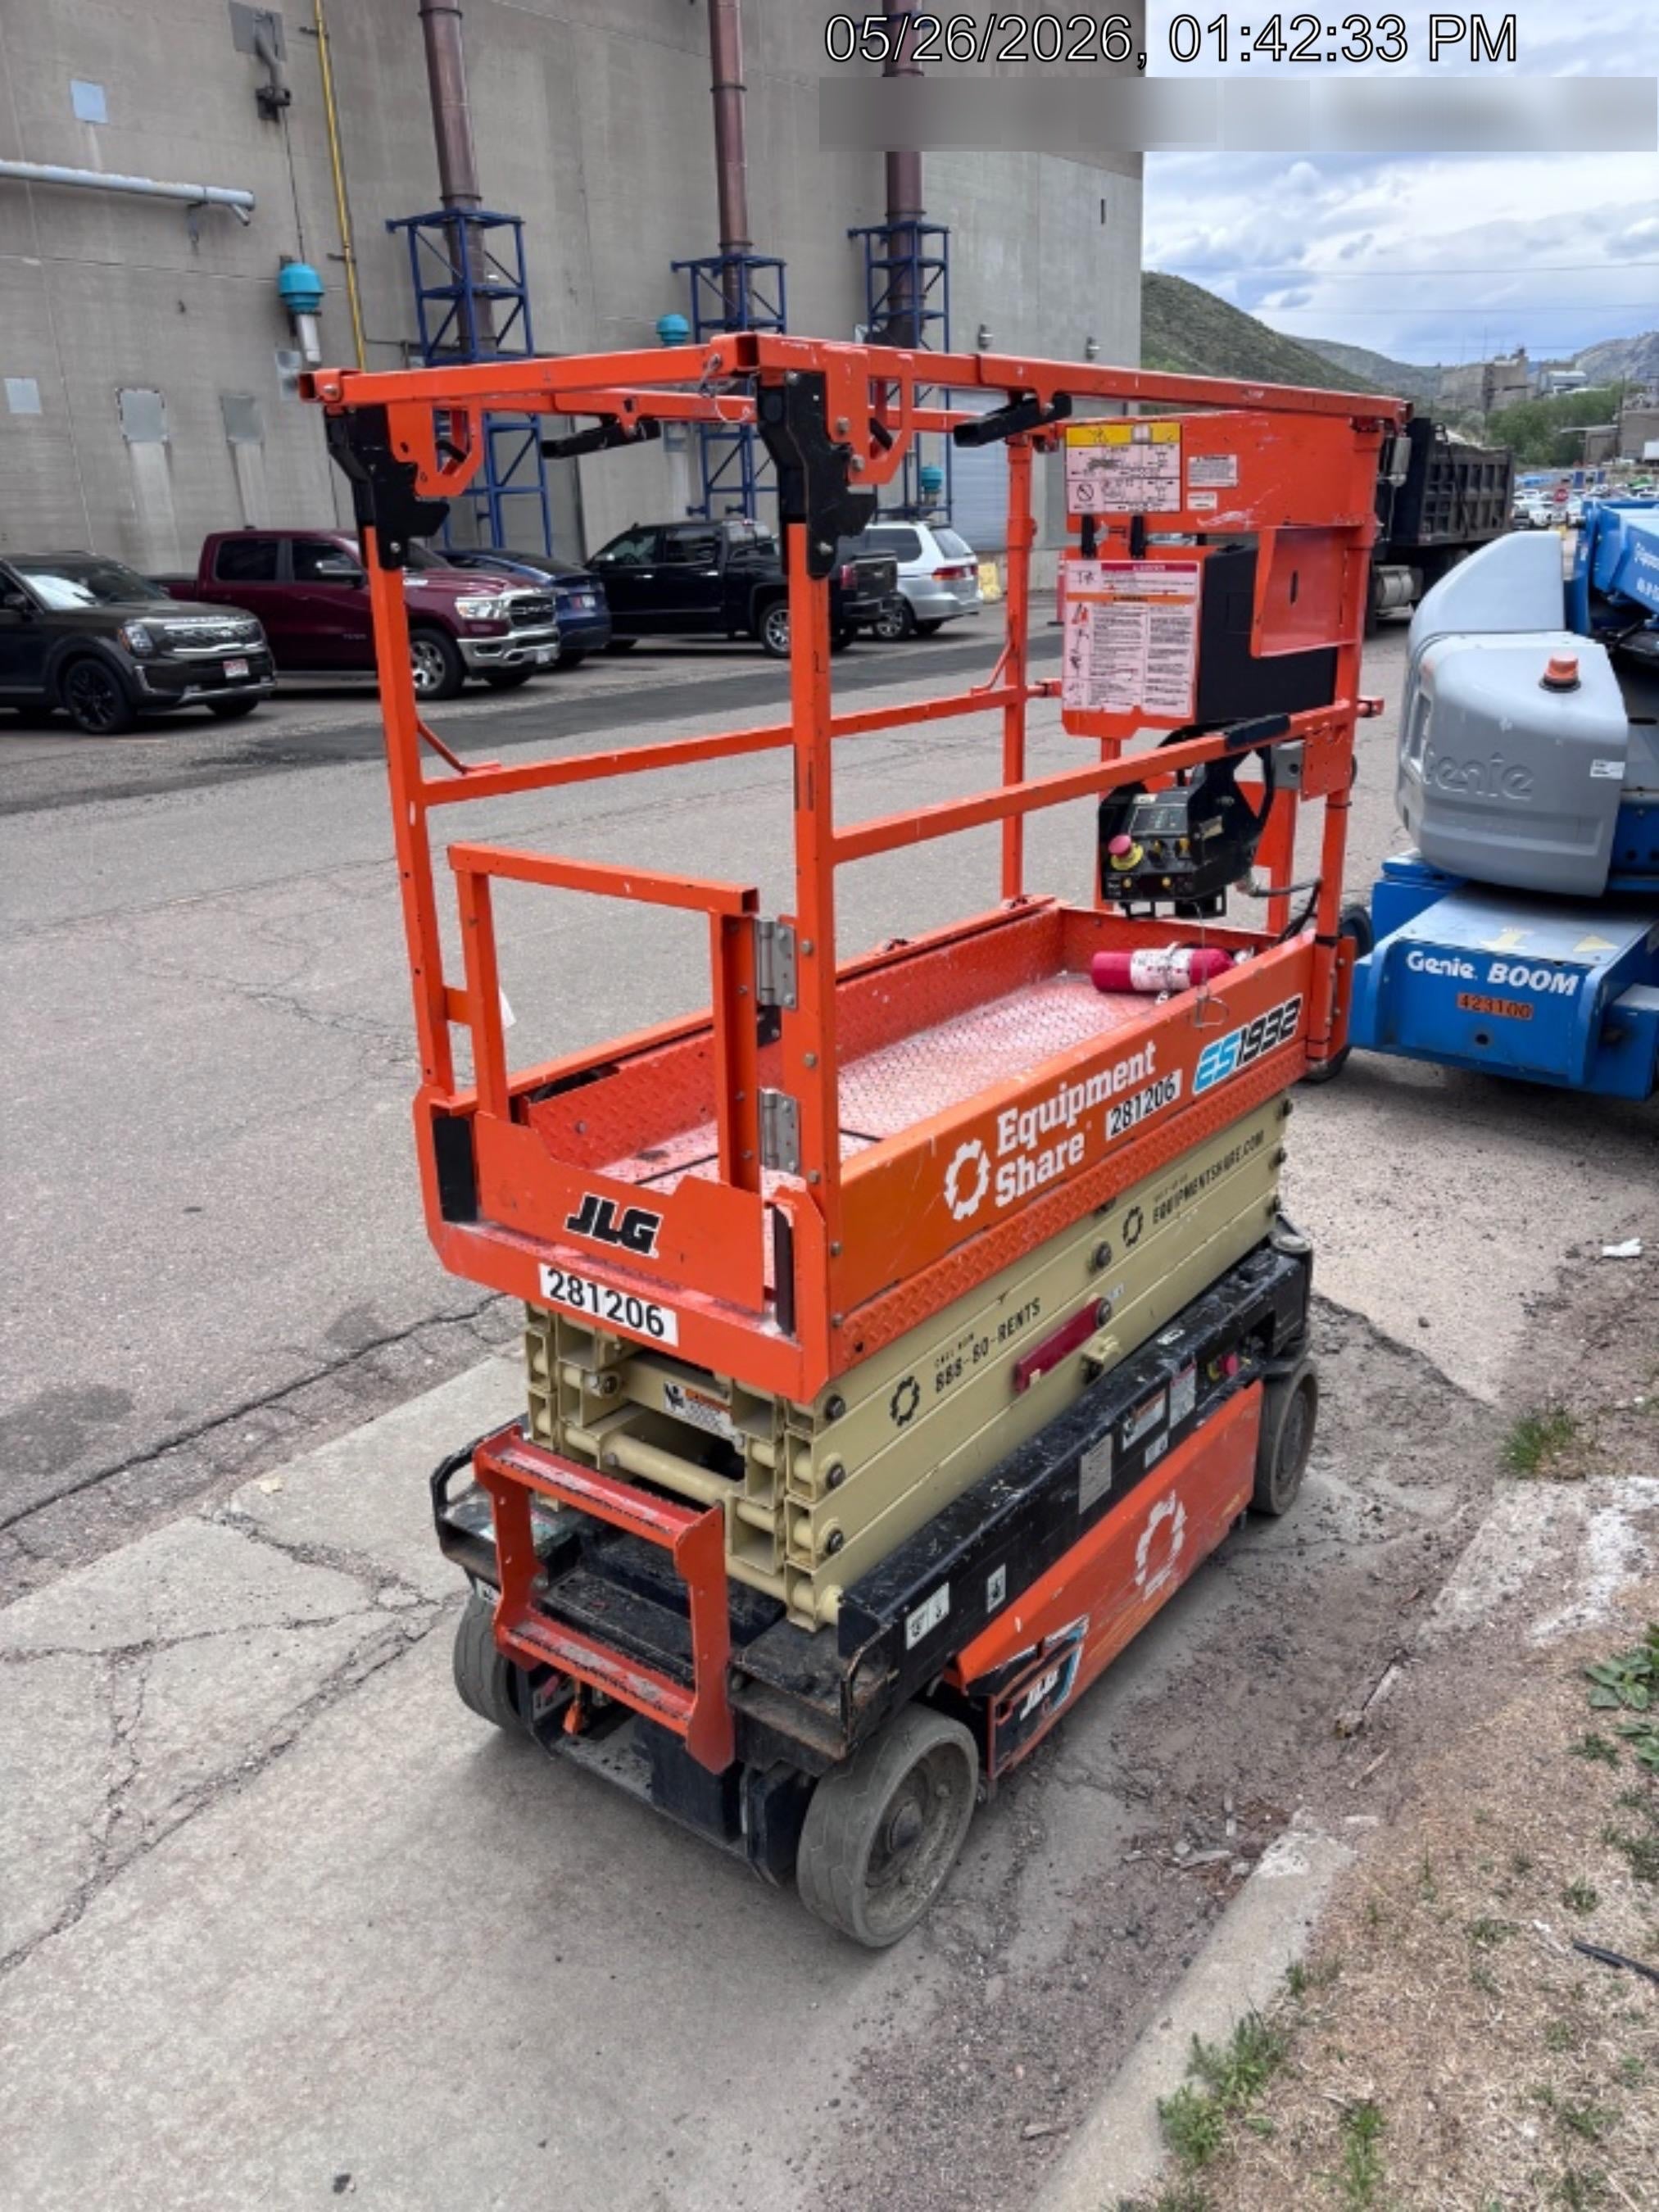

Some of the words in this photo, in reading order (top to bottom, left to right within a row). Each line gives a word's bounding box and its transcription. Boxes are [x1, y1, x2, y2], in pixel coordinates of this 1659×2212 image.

[1406, 950, 1477, 980] Genie
[1487, 962, 1580, 996] BOOM
[1193, 993, 1303, 1095] ES1932
[996, 1042, 1156, 1157] Equipment
[1110, 1072, 1176, 1136] 281206
[995, 1132, 1086, 1208] Share
[565, 1194, 663, 1256] JLG
[547, 1267, 665, 1337] 281206
